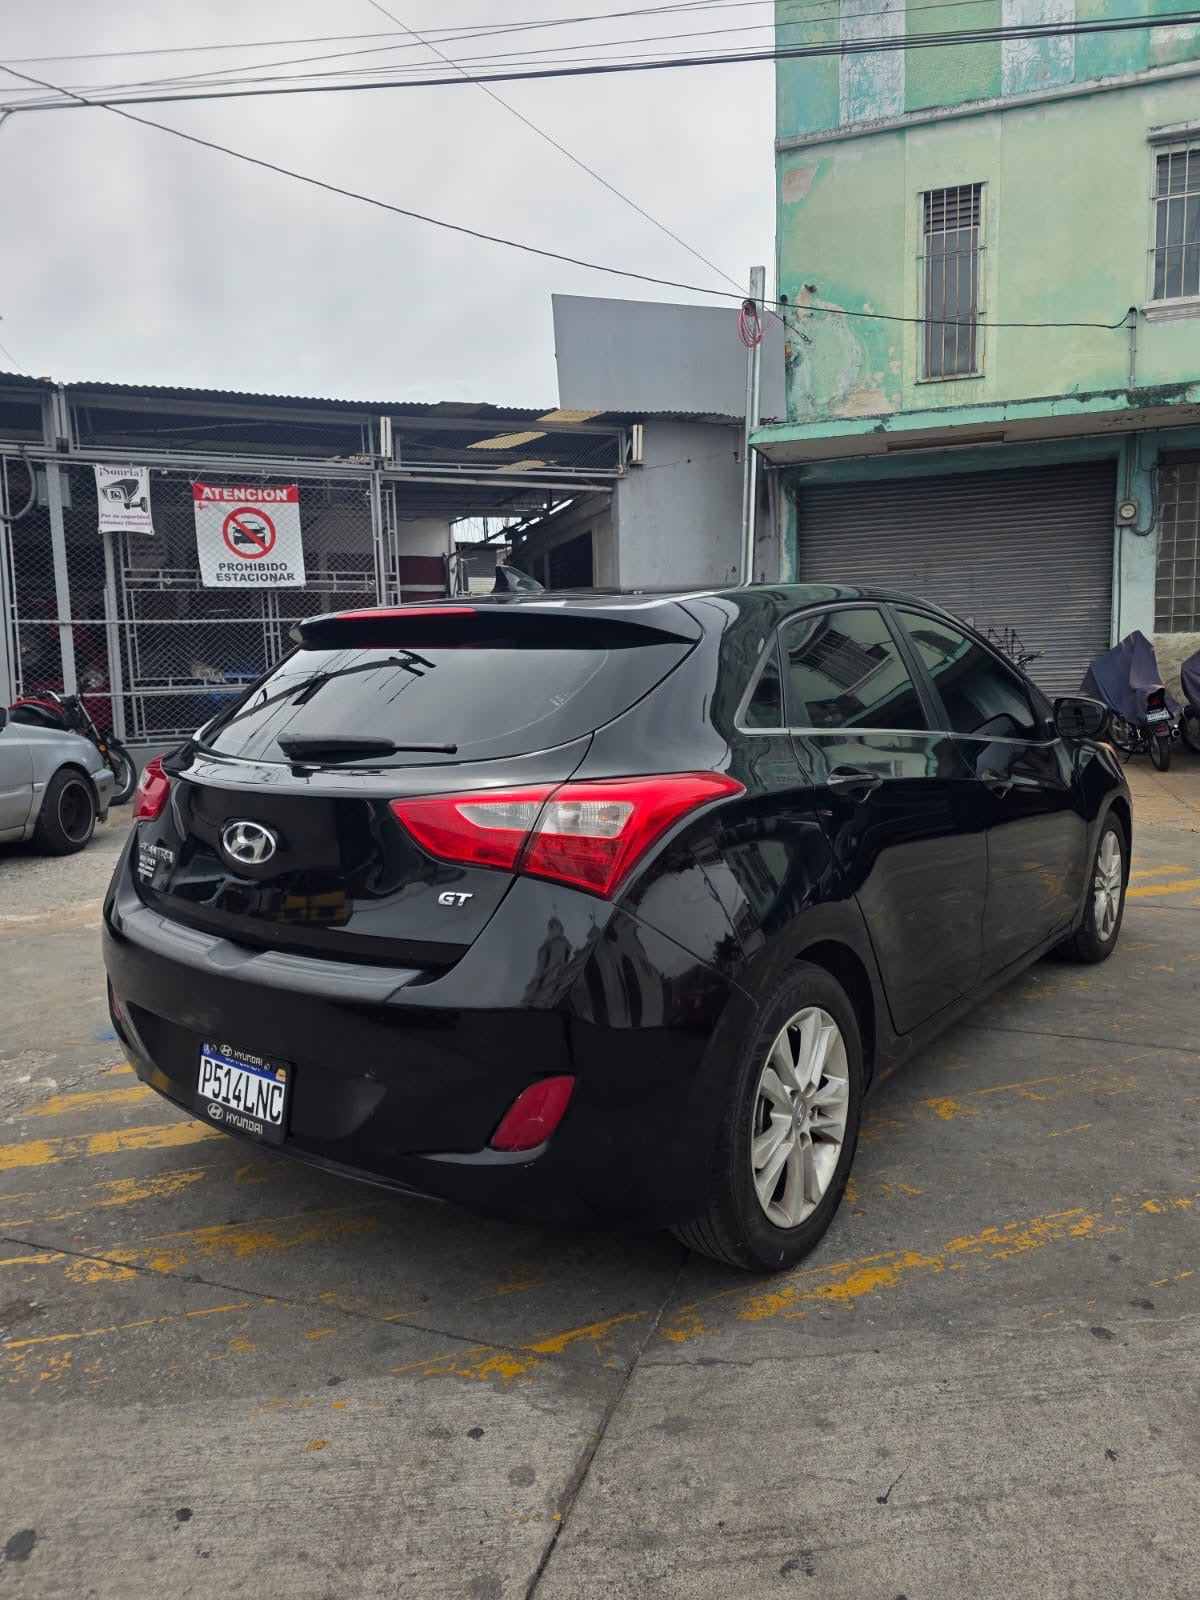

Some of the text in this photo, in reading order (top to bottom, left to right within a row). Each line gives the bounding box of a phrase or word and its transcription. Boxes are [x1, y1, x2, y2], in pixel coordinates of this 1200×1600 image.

[201, 487, 288, 501] ATENCION
[219, 563, 288, 572] PROHIBIDO
[216, 573, 295, 582] ESTACIONAR
[438, 892, 473, 906] GT
[234, 1050, 263, 1066] HYUNDAI
[202, 1059, 283, 1122] P514LNC
[225, 1112, 263, 1135] HYUNDAI
